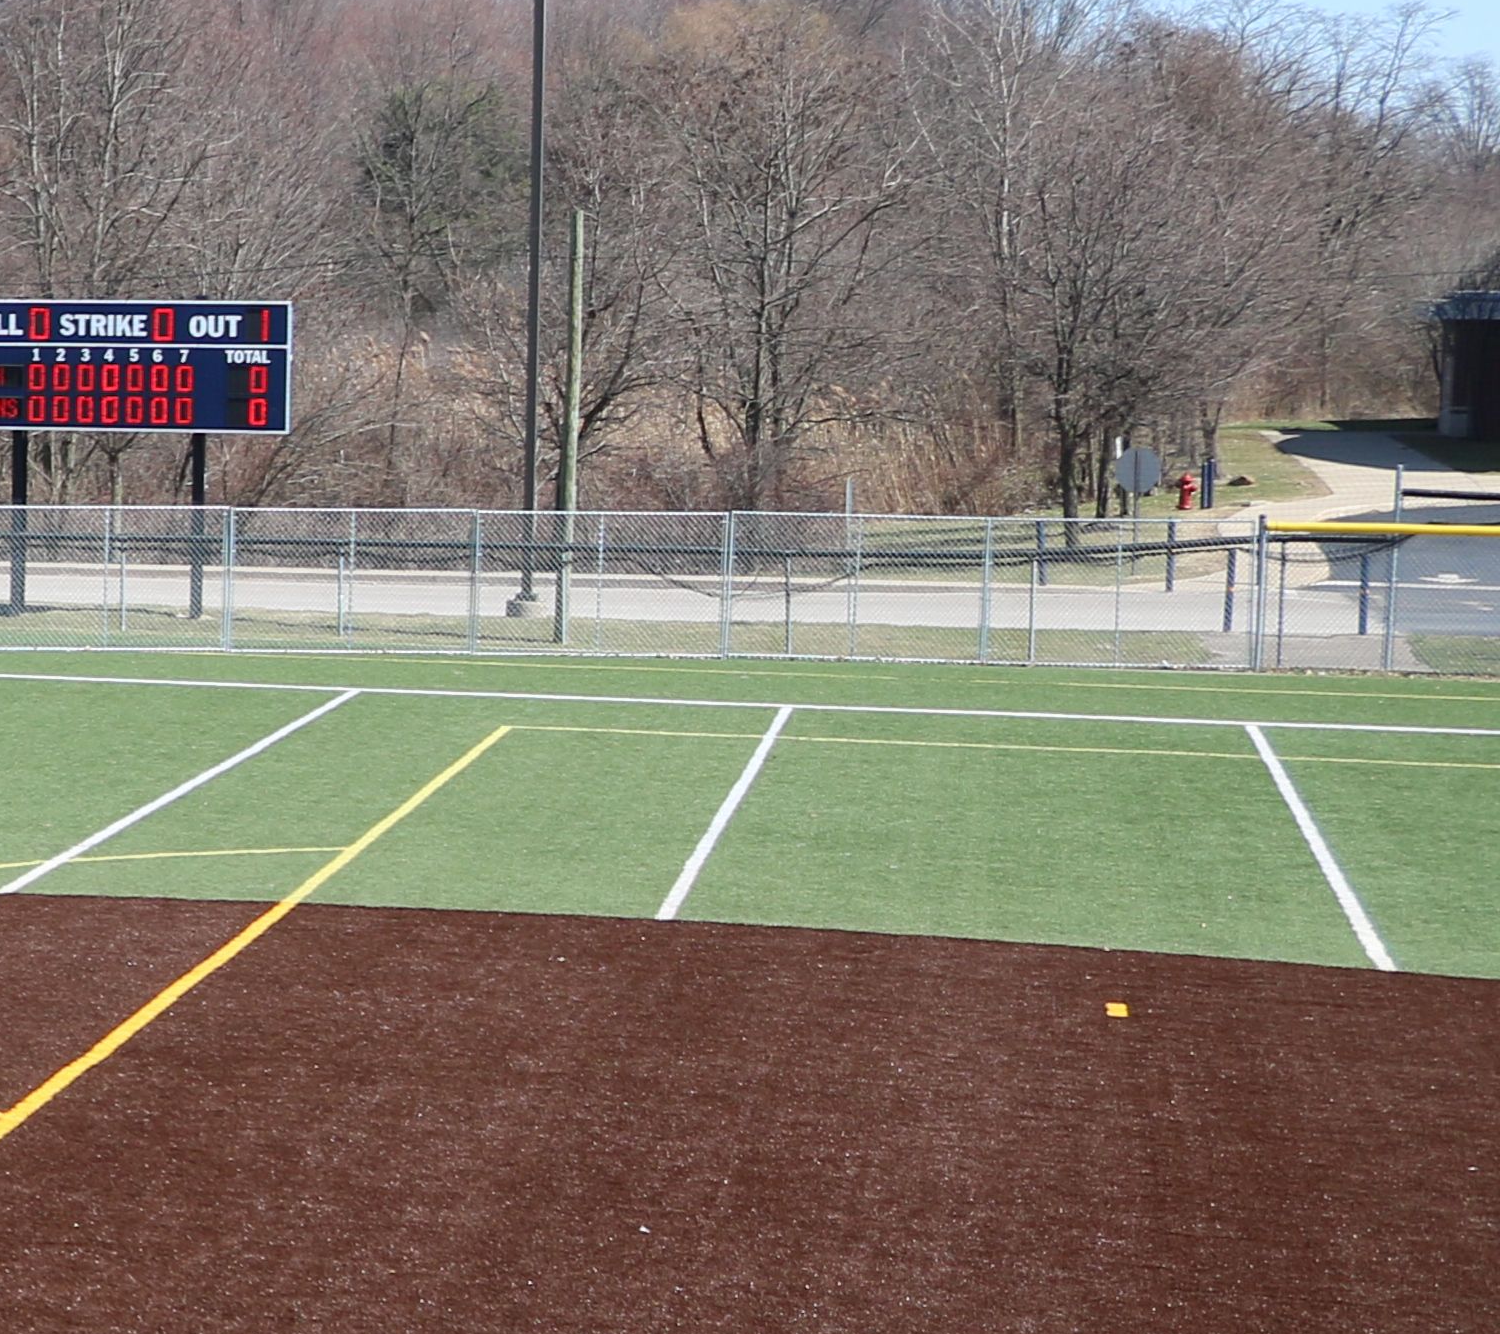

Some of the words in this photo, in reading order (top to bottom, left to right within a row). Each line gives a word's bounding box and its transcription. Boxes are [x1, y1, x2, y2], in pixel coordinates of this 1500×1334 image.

[29, 307, 51, 340] 0
[59, 313, 148, 337] STRIKE
[153, 307, 175, 341] 0
[189, 315, 243, 338] OUT
[262, 309, 270, 342] 1
[32, 348, 41, 362] 1
[55, 348, 66, 362] 2
[80, 348, 91, 362] 3
[103, 348, 115, 362] 4
[129, 348, 140, 362] 5
[152, 349, 164, 363] 6
[179, 349, 190, 363] 7
[224, 350, 271, 364] TOTAL
[28, 363, 46, 391] 0
[52, 363, 70, 391] 0
[77, 364, 95, 391] 0
[101, 364, 119, 392] 0
[126, 364, 144, 392] 0
[150, 364, 169, 392] 0
[176, 364, 194, 392] 0
[250, 366, 268, 394] 0
[28, 395, 45, 422] 0
[52, 395, 70, 423] 0
[77, 395, 94, 423] 0
[101, 395, 119, 424] 0
[126, 396, 143, 424] 0
[150, 396, 168, 424] 0
[175, 397, 193, 424] 0
[248, 398, 267, 425] 0
